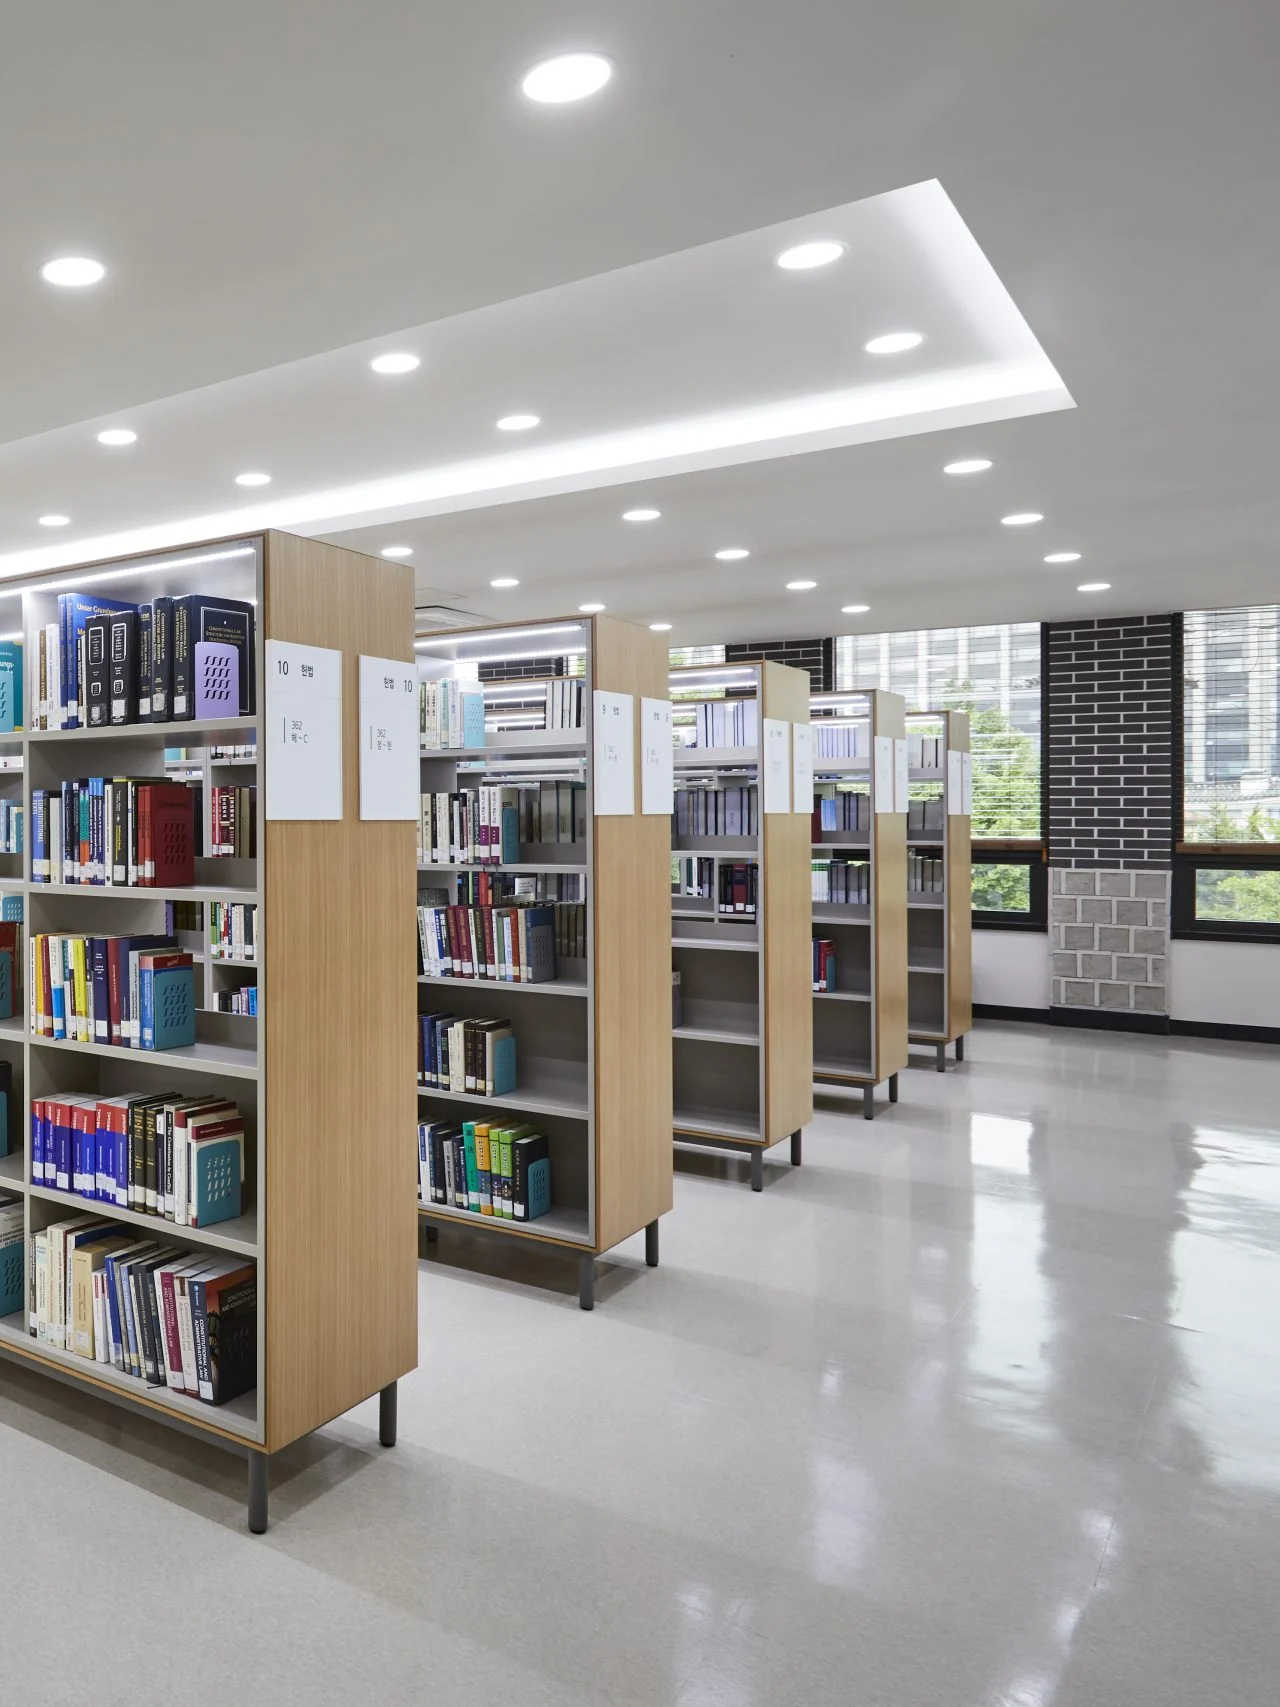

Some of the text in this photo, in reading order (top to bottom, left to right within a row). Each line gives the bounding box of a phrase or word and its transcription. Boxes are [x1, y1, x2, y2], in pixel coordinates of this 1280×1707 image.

[277, 660, 314, 678] 10 헌법
[383, 676, 413, 693] 헌법 10
[291, 720, 303, 731] 362
[376, 728, 387, 738] 362
[194, 1320, 202, 1365] ADMINISTRATIVE
